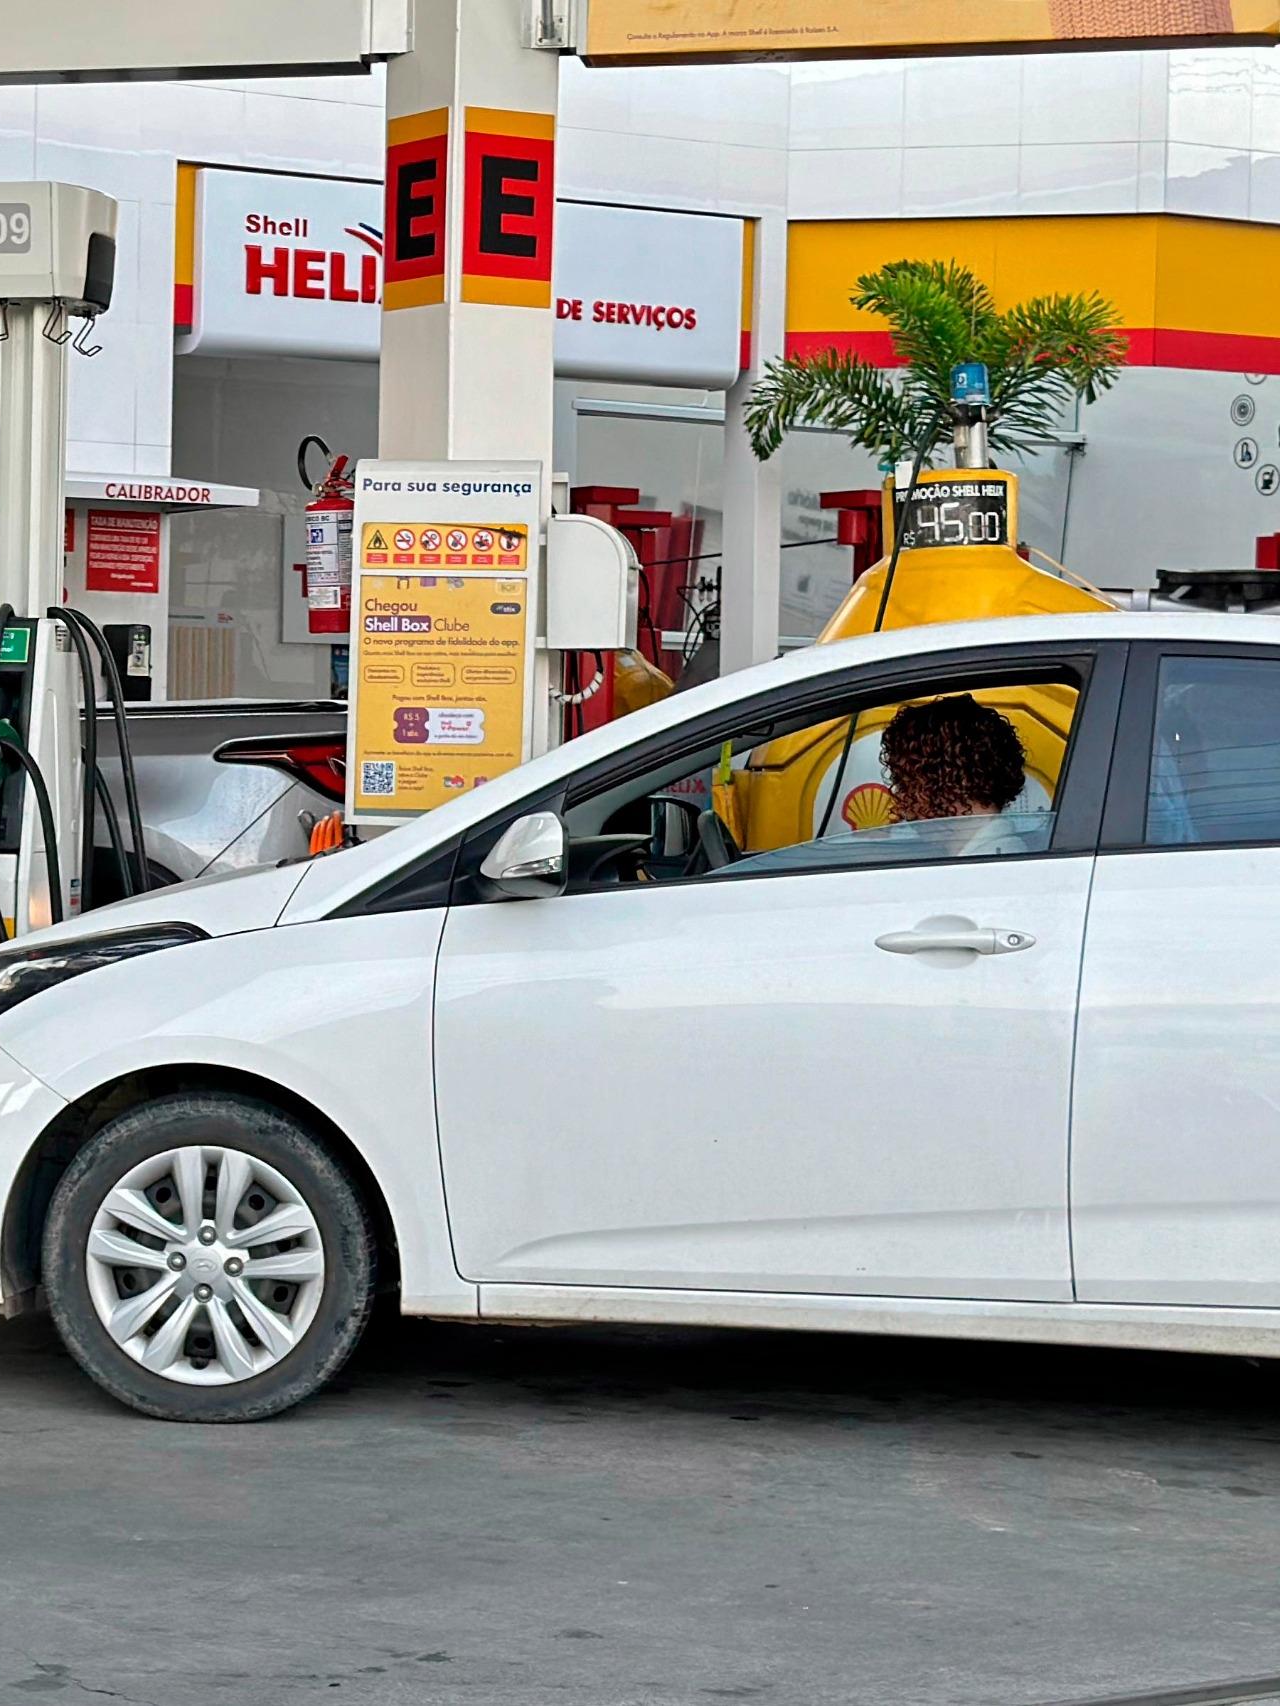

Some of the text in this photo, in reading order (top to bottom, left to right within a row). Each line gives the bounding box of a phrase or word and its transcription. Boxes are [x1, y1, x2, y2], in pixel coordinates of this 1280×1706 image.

[397, 158, 437, 261] E
[480, 154, 539, 258] E
[246, 214, 308, 238] Shell
[245, 245, 381, 305] HELI
[556, 298, 697, 331] DE SERVIÇOS
[106, 483, 211, 502] CALIBRADOR
[363, 478, 532, 497] Para sua segurança
[896, 484, 1004, 503] PRMOÇÃO SHELL HELIX
[917, 502, 1000, 545] 45,00
[364, 598, 418, 615] Chegou
[365, 618, 470, 632] Shell Box Clube
[364, 637, 371, 645] O
[394, 639, 434, 648] programa
[436, 637, 447, 646] de
[448, 637, 488, 646] fidelidade
[489, 637, 500, 646] do
